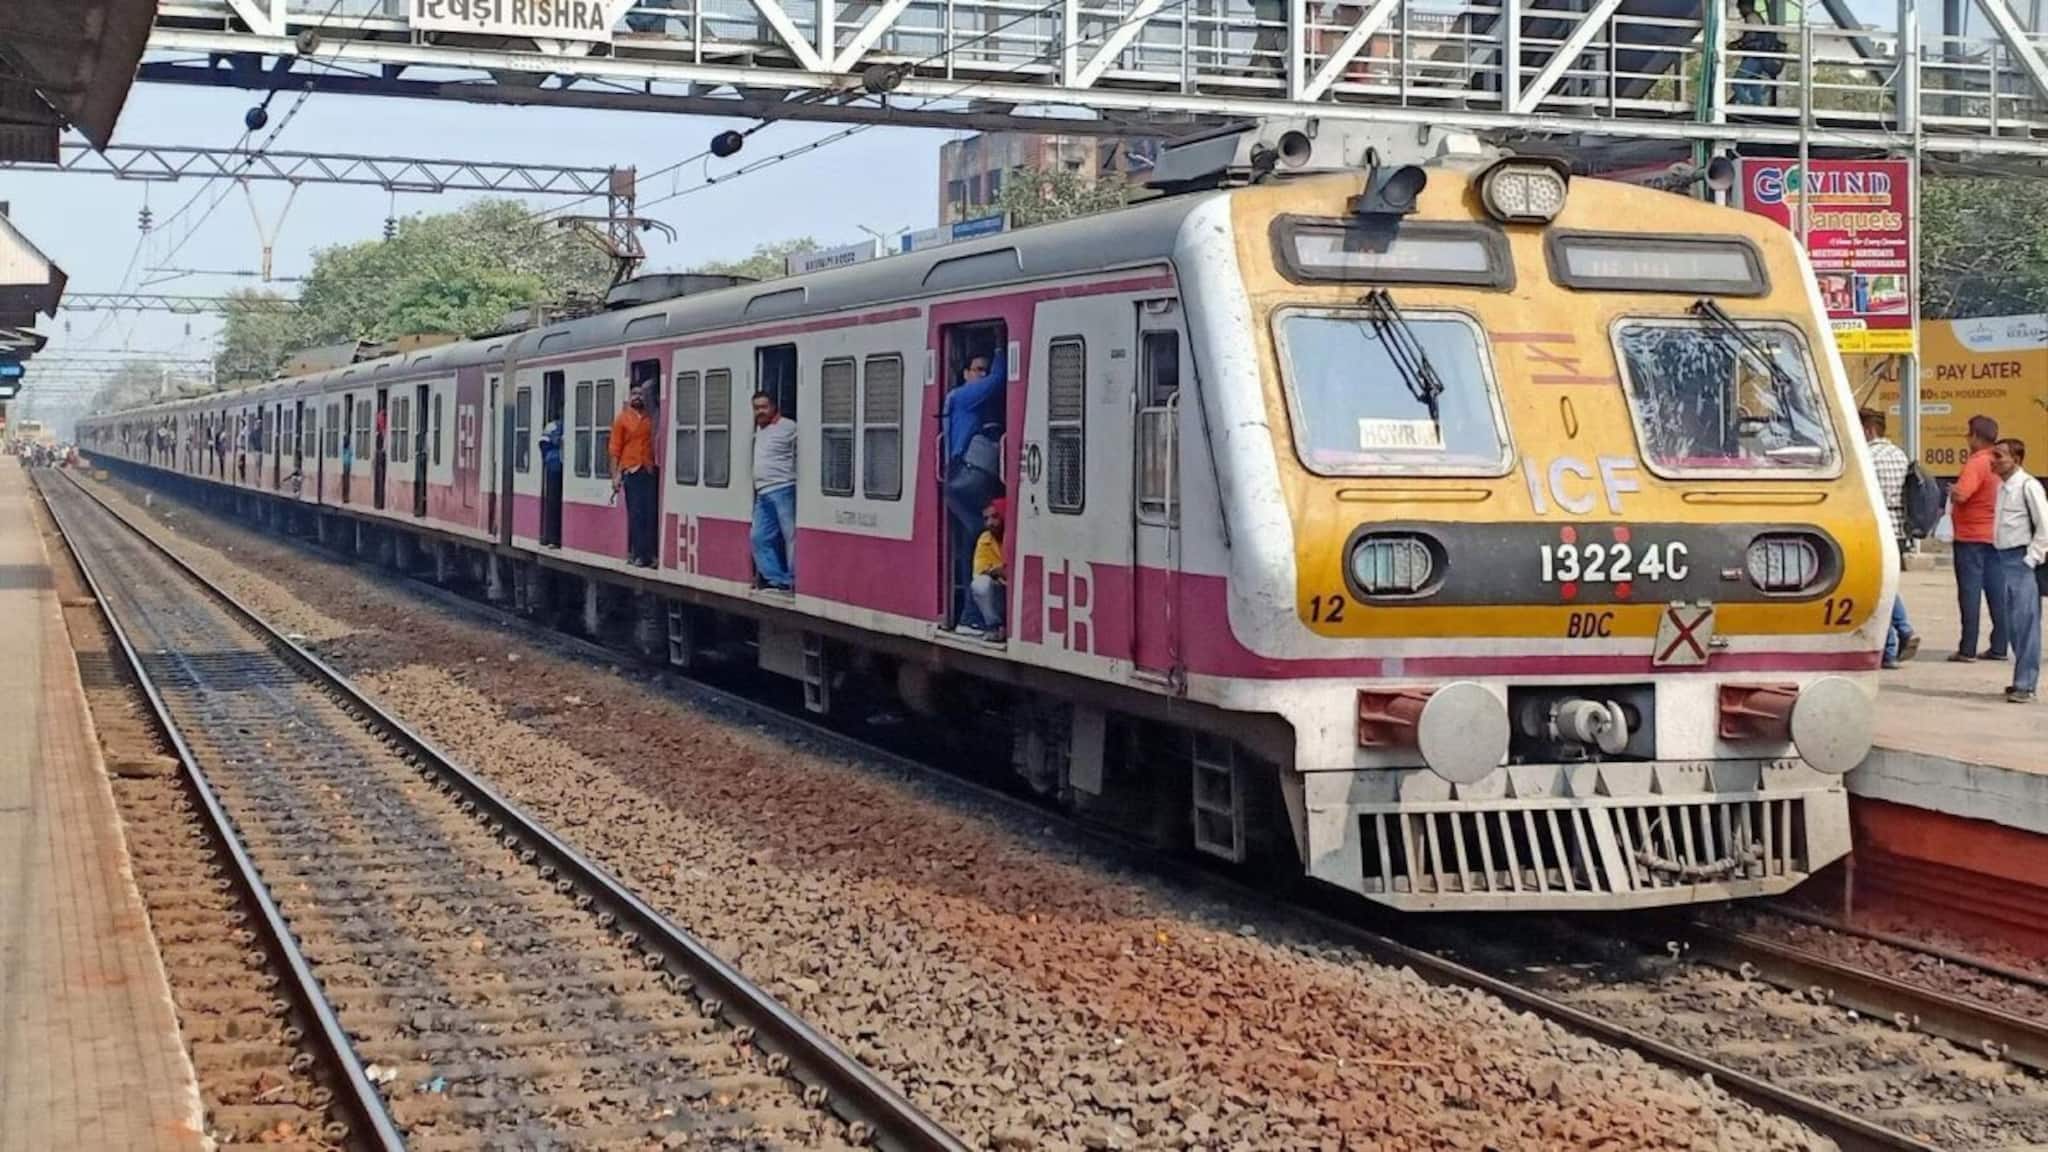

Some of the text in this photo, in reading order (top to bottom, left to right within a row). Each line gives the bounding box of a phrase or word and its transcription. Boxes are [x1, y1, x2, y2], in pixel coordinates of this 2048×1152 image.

[512, 0, 604, 31] RISHRA
[1936, 363, 1967, 380] PAY
[1971, 361, 2022, 379] LATER
[1925, 447, 1954, 465] 808
[1520, 453, 1641, 516] ICF
[1540, 541, 1689, 582] 13224C
[1042, 556, 1096, 656] ER
[1310, 594, 1346, 623] 12
[1823, 599, 1854, 626] 12
[1567, 612, 1614, 637] BDC
